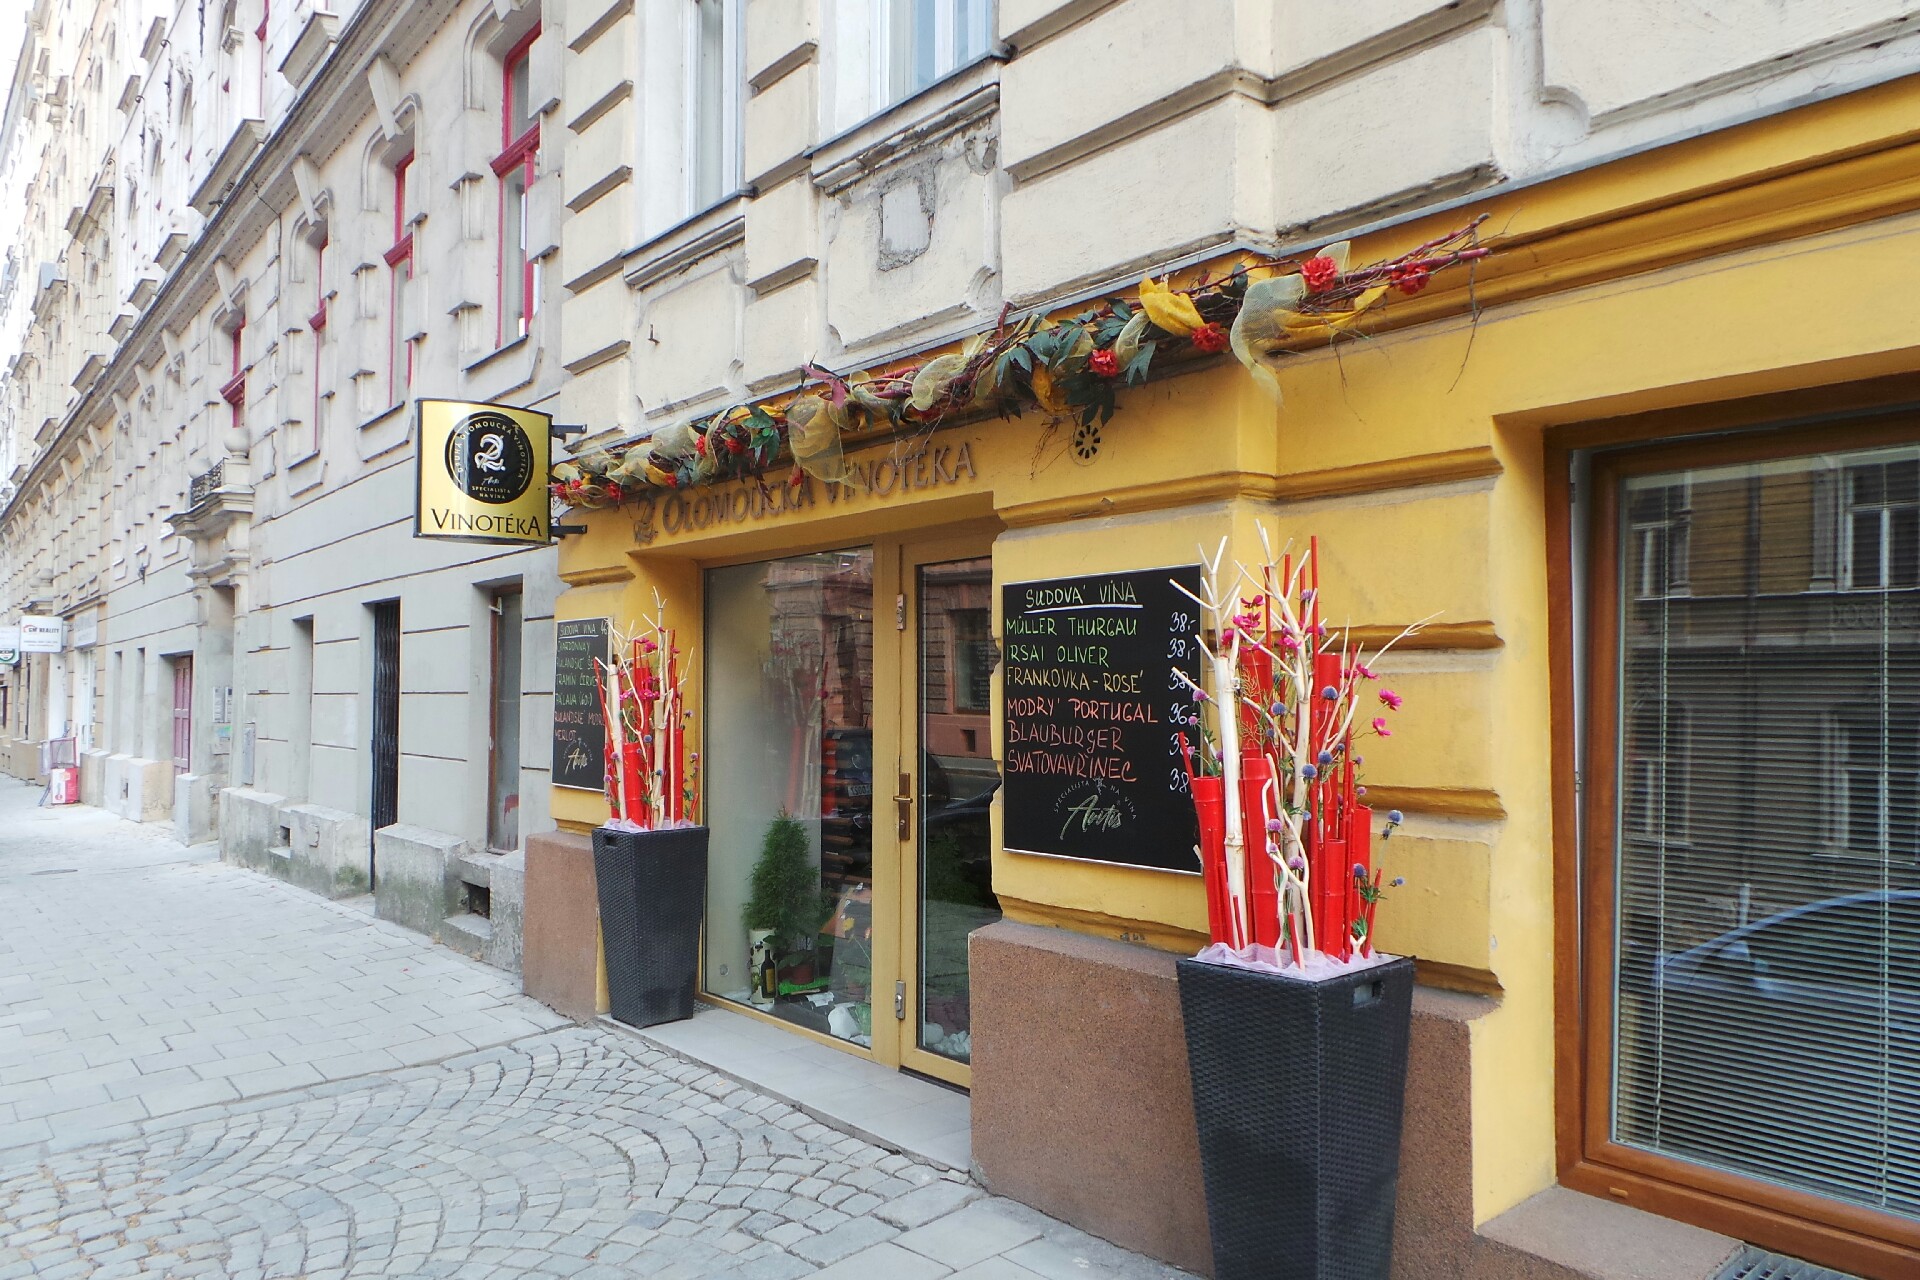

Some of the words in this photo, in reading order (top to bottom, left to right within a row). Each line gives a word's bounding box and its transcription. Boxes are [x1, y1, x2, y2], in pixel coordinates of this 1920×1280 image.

[471, 486, 511, 494] SPECIALISTA
[431, 508, 542, 537] VINOTÉKA
[1068, 617, 1137, 636] THURGAU
[1006, 644, 1045, 662] IRSAI
[1057, 646, 1110, 668] OLIVER
[1068, 698, 1158, 724] PORTUGAL
[1007, 719, 1124, 754] BLAUBURGER
[1053, 780, 1090, 814] SPECIALISTA
